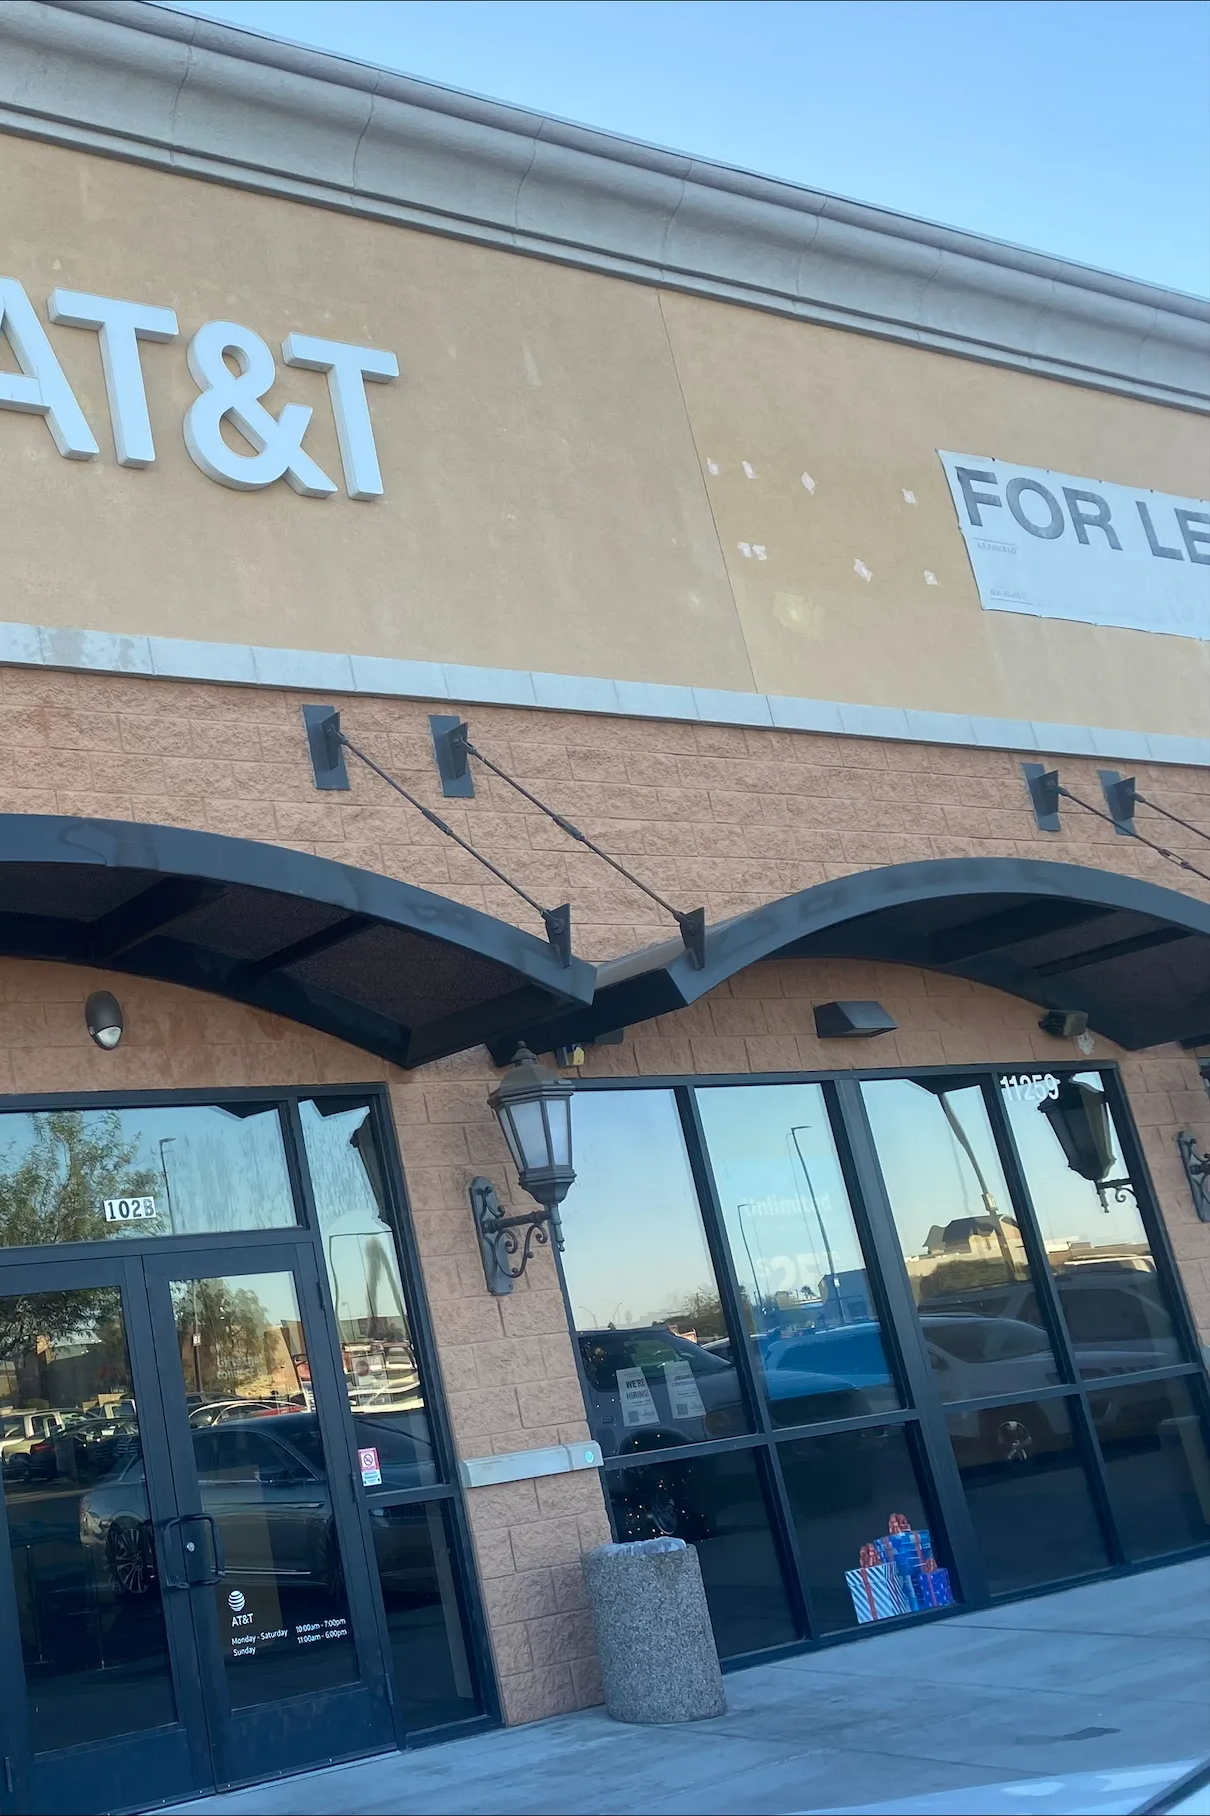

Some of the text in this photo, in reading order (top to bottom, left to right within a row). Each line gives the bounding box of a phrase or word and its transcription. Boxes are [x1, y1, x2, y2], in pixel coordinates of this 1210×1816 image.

[954, 466, 1210, 566] FOR LE
[999, 1073, 1061, 1102] 11259
[231, 1613, 254, 1627] AT&T
[231, 1635, 256, 1646] Monday
[260, 1628, 289, 1641] Saturday
[295, 1622, 321, 1634] 10:00am
[324, 1617, 347, 1628] 7:00pm
[233, 1646, 256, 1657] Sunday
[297, 1633, 321, 1645] 11:00am
[325, 1628, 348, 1639] 6:00pm
